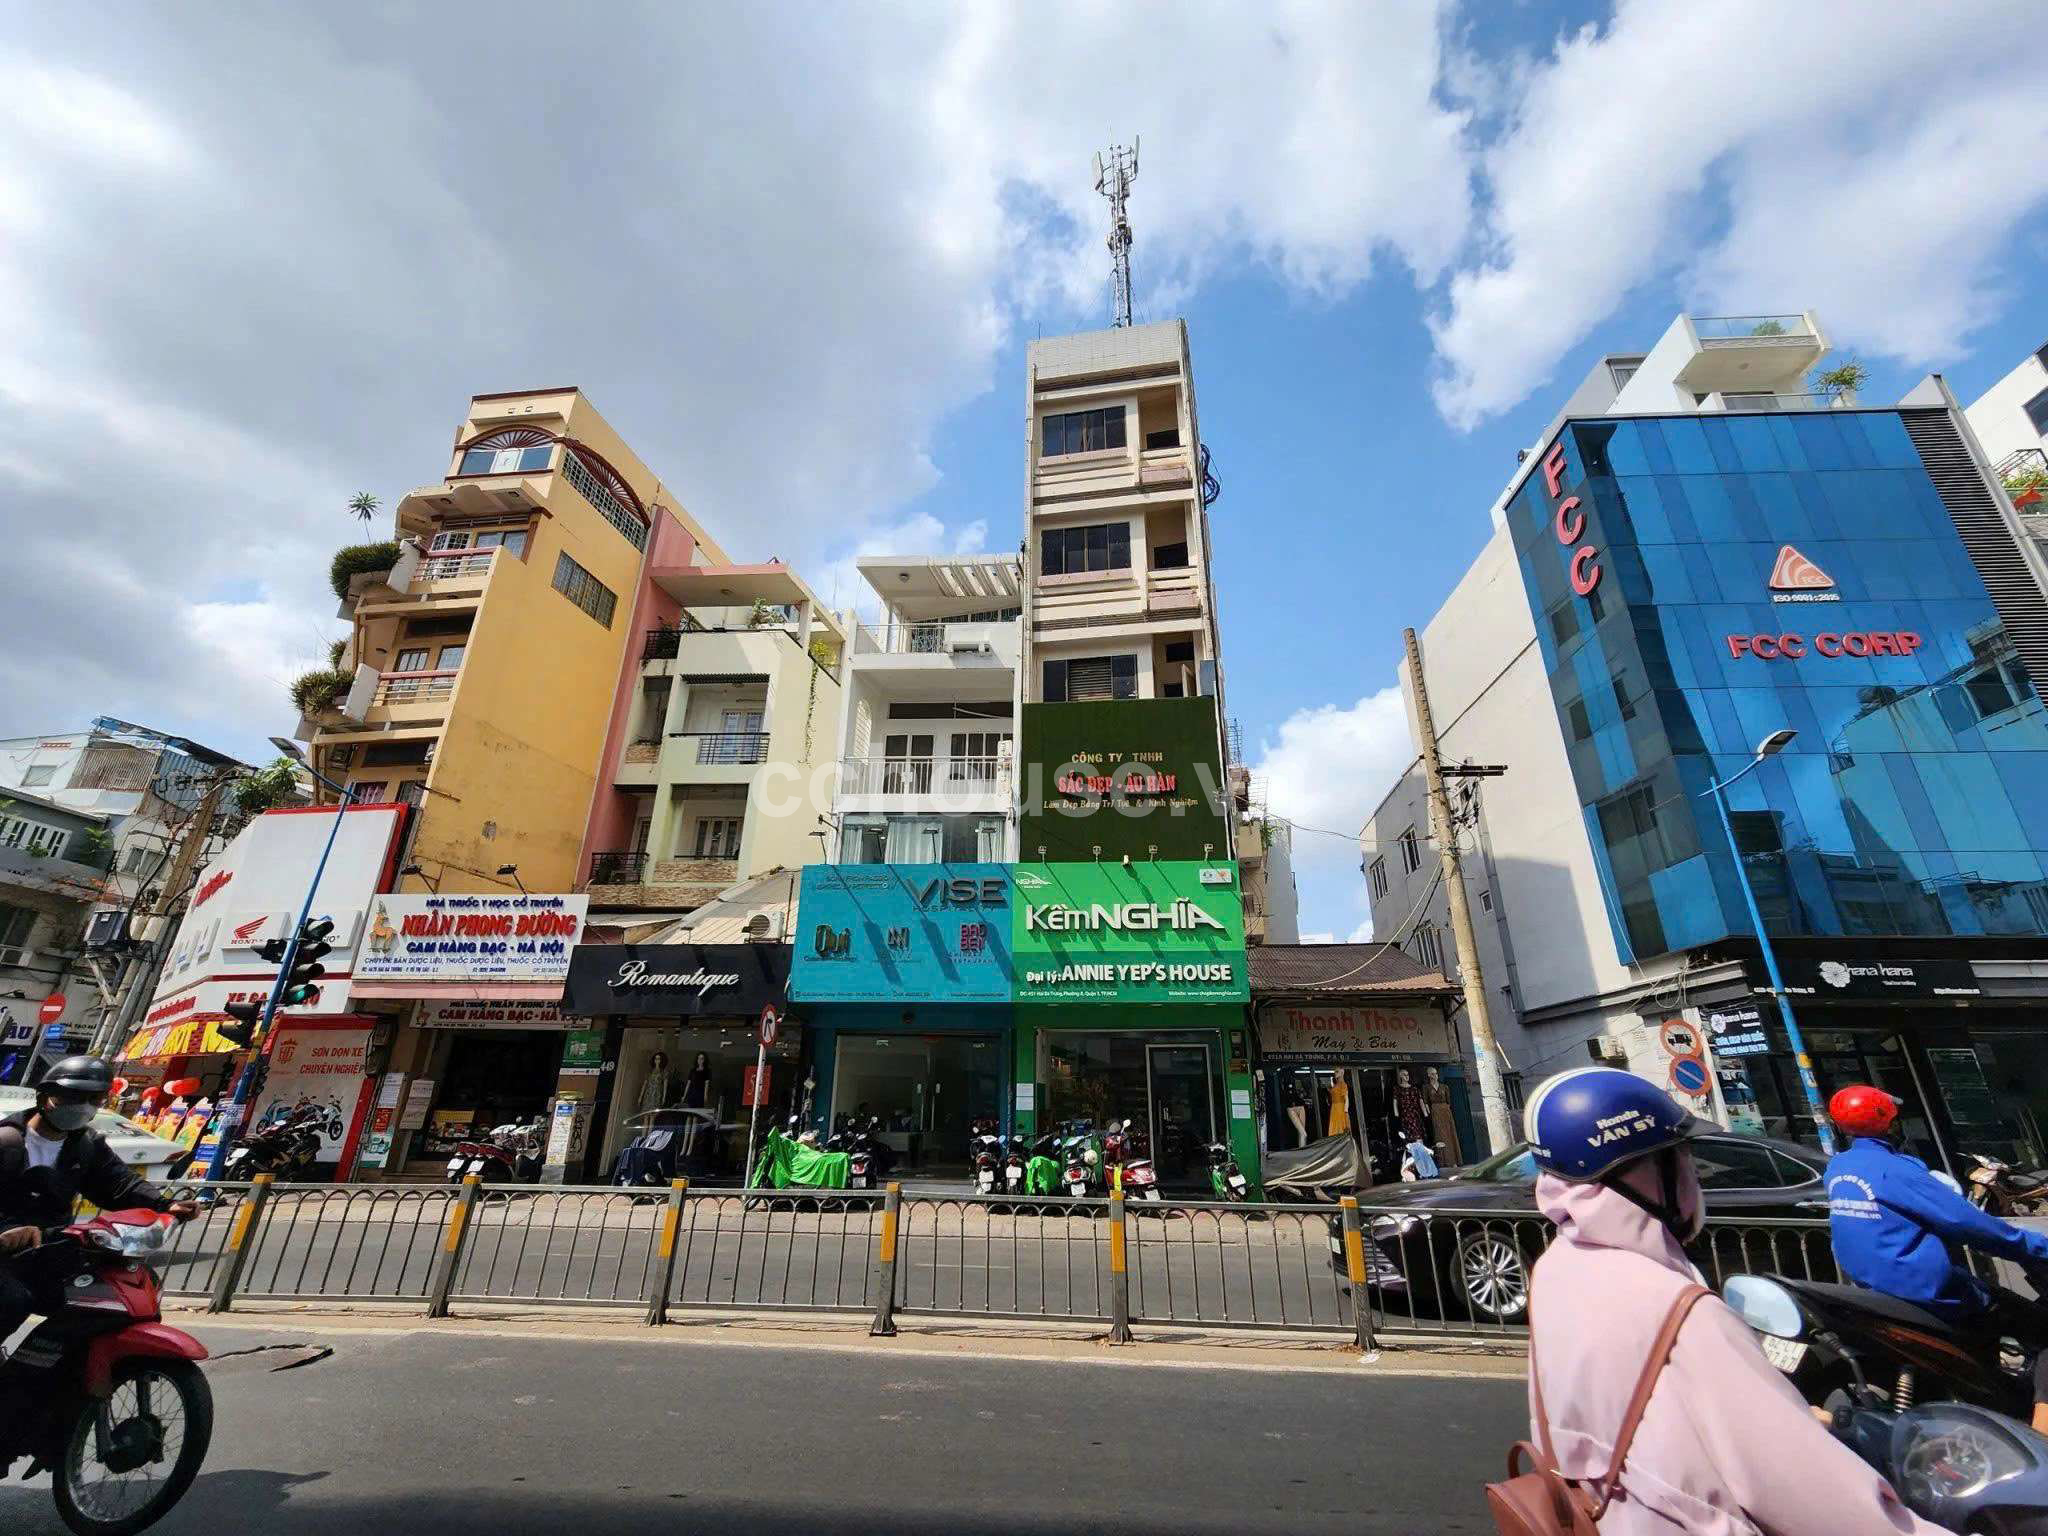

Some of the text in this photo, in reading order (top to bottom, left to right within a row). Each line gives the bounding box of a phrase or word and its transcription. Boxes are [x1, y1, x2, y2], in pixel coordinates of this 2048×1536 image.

[1543, 442, 1603, 597] FCC
[1726, 631, 1922, 660] FCC CORP
[1071, 751, 1164, 763] CÔNG TY TNHH
[1125, 772, 1143, 793] ÂU
[905, 878, 1005, 902] VISE
[426, 897, 445, 907] NHÀ
[449, 896, 479, 907] THUỐC
[489, 899, 511, 908] HỌC
[530, 896, 563, 907] TRUYỀN
[400, 909, 577, 937] NHÂN PHONG ĐƯỜNG
[438, 939, 477, 953] HÀNG
[480, 941, 507, 955] BẠC
[517, 939, 536, 953] HÀ
[540, 939, 564, 955] NỘI
[608, 960, 740, 997] Romantique
[1026, 972, 1044, 983] Đại
[1062, 965, 1114, 982] ANNIE
[1116, 963, 1167, 982] YEP'S
[1168, 965, 1232, 982] HOUSE
[507, 1010, 534, 1024] BẠC
[351, 1047, 364, 1057] XE
[1312, 1036, 1347, 1050] May
